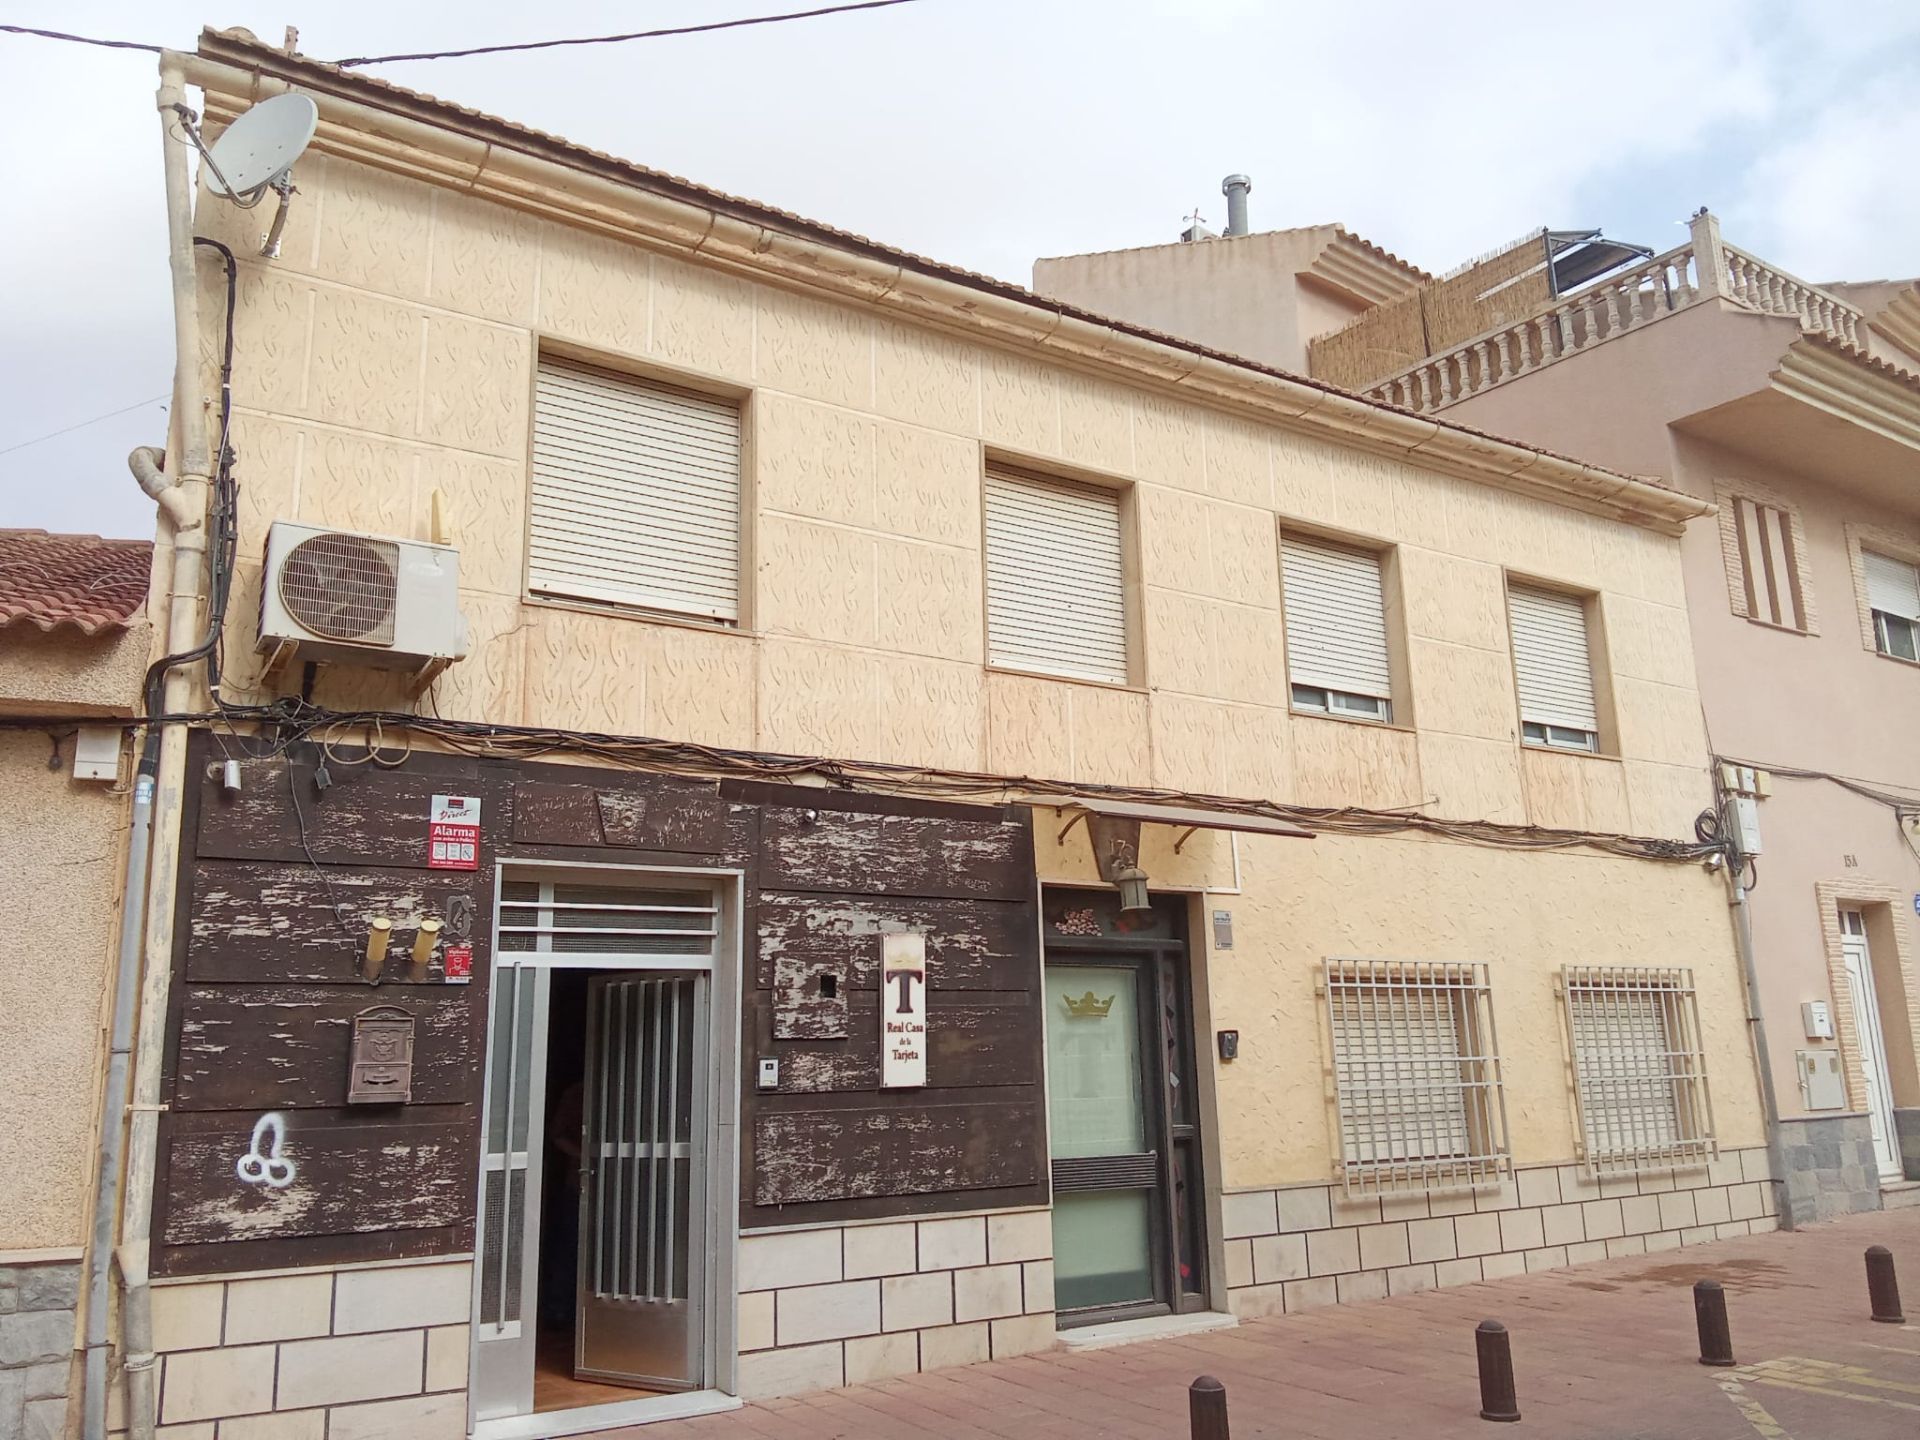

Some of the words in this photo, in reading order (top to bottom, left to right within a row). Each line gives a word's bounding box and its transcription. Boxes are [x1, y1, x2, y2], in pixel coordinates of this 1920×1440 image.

[433, 825, 475, 837] Alarma
[1843, 854, 1858, 868] 15A
[886, 969, 923, 1014] T
[887, 1021, 904, 1033] Real
[905, 1021, 924, 1033] Casa
[899, 1037, 906, 1046] de
[906, 1037, 912, 1046] la
[892, 1049, 919, 1064] Tarjeta
